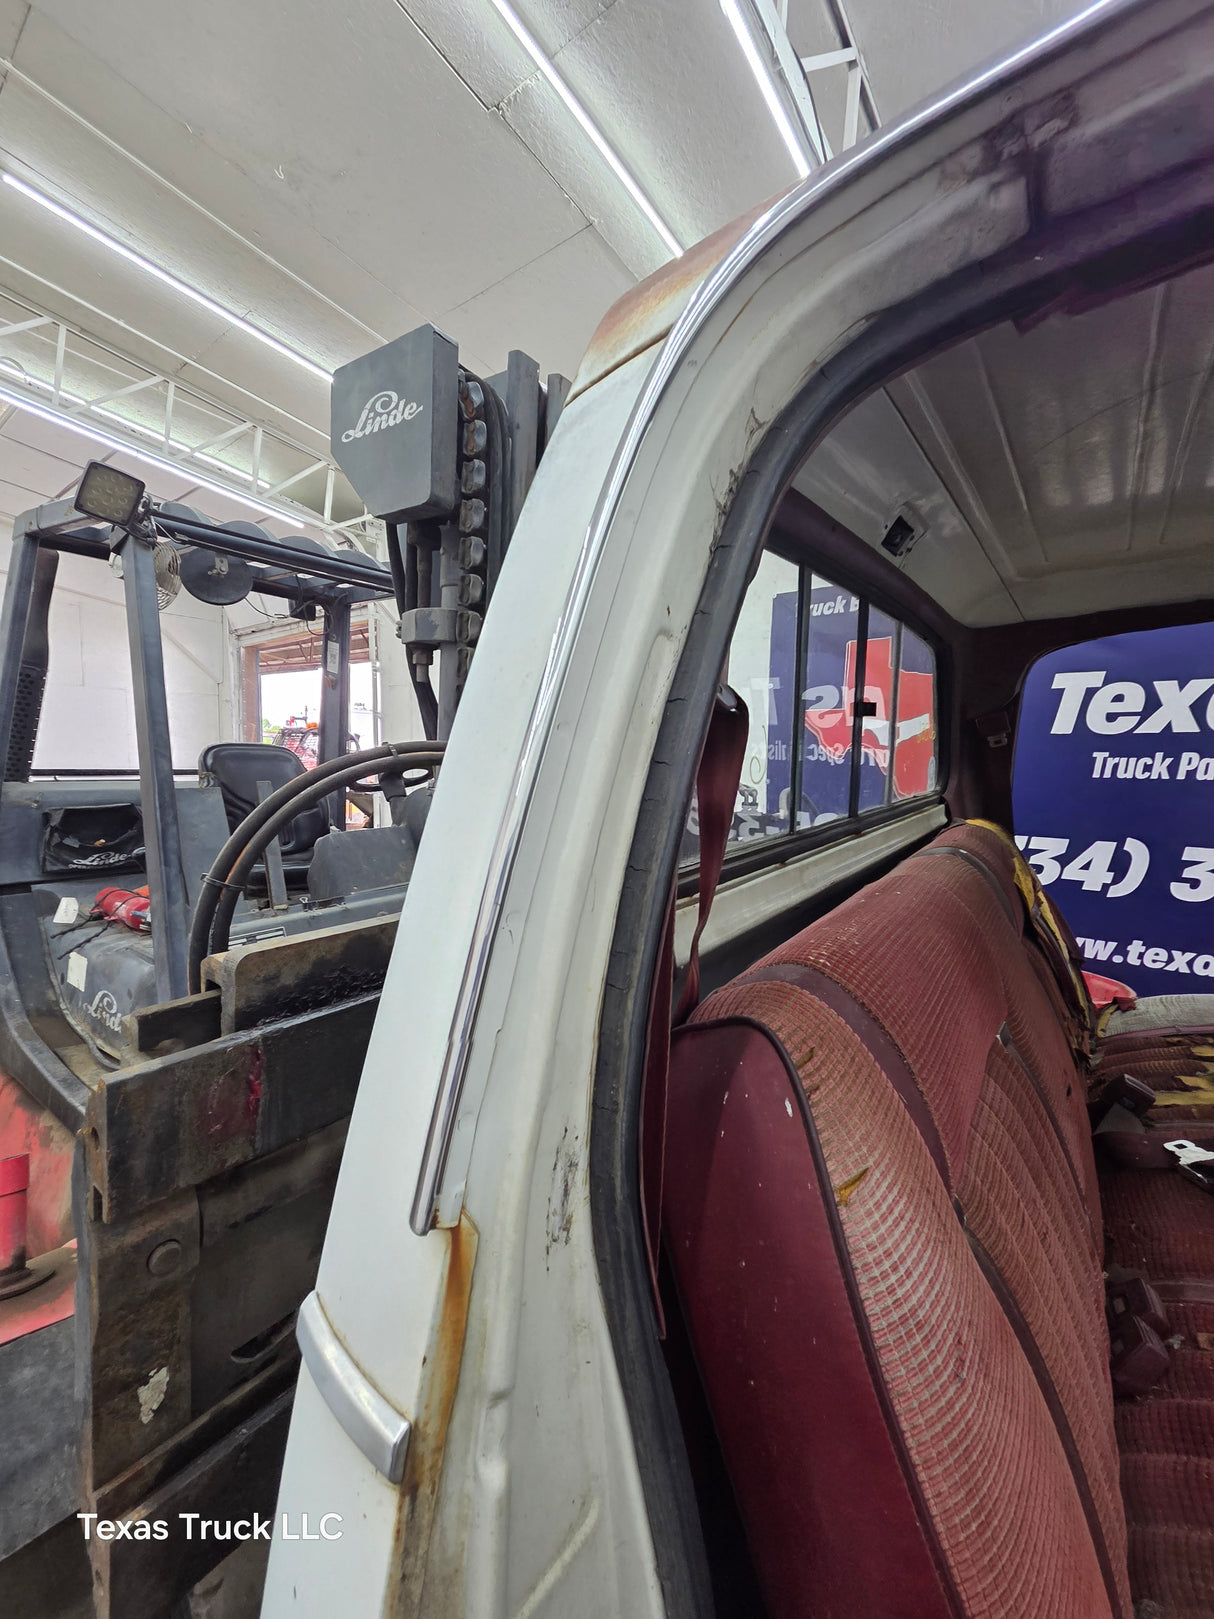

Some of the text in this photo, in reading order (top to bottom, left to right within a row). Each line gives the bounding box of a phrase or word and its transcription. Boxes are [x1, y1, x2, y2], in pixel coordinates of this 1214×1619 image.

[341, 390, 424, 443] Linde
[1050, 671, 1214, 735] Tex
[1092, 751, 1174, 780] Truck
[1014, 834, 1150, 898] 34)
[82, 990, 121, 1033] Lind
